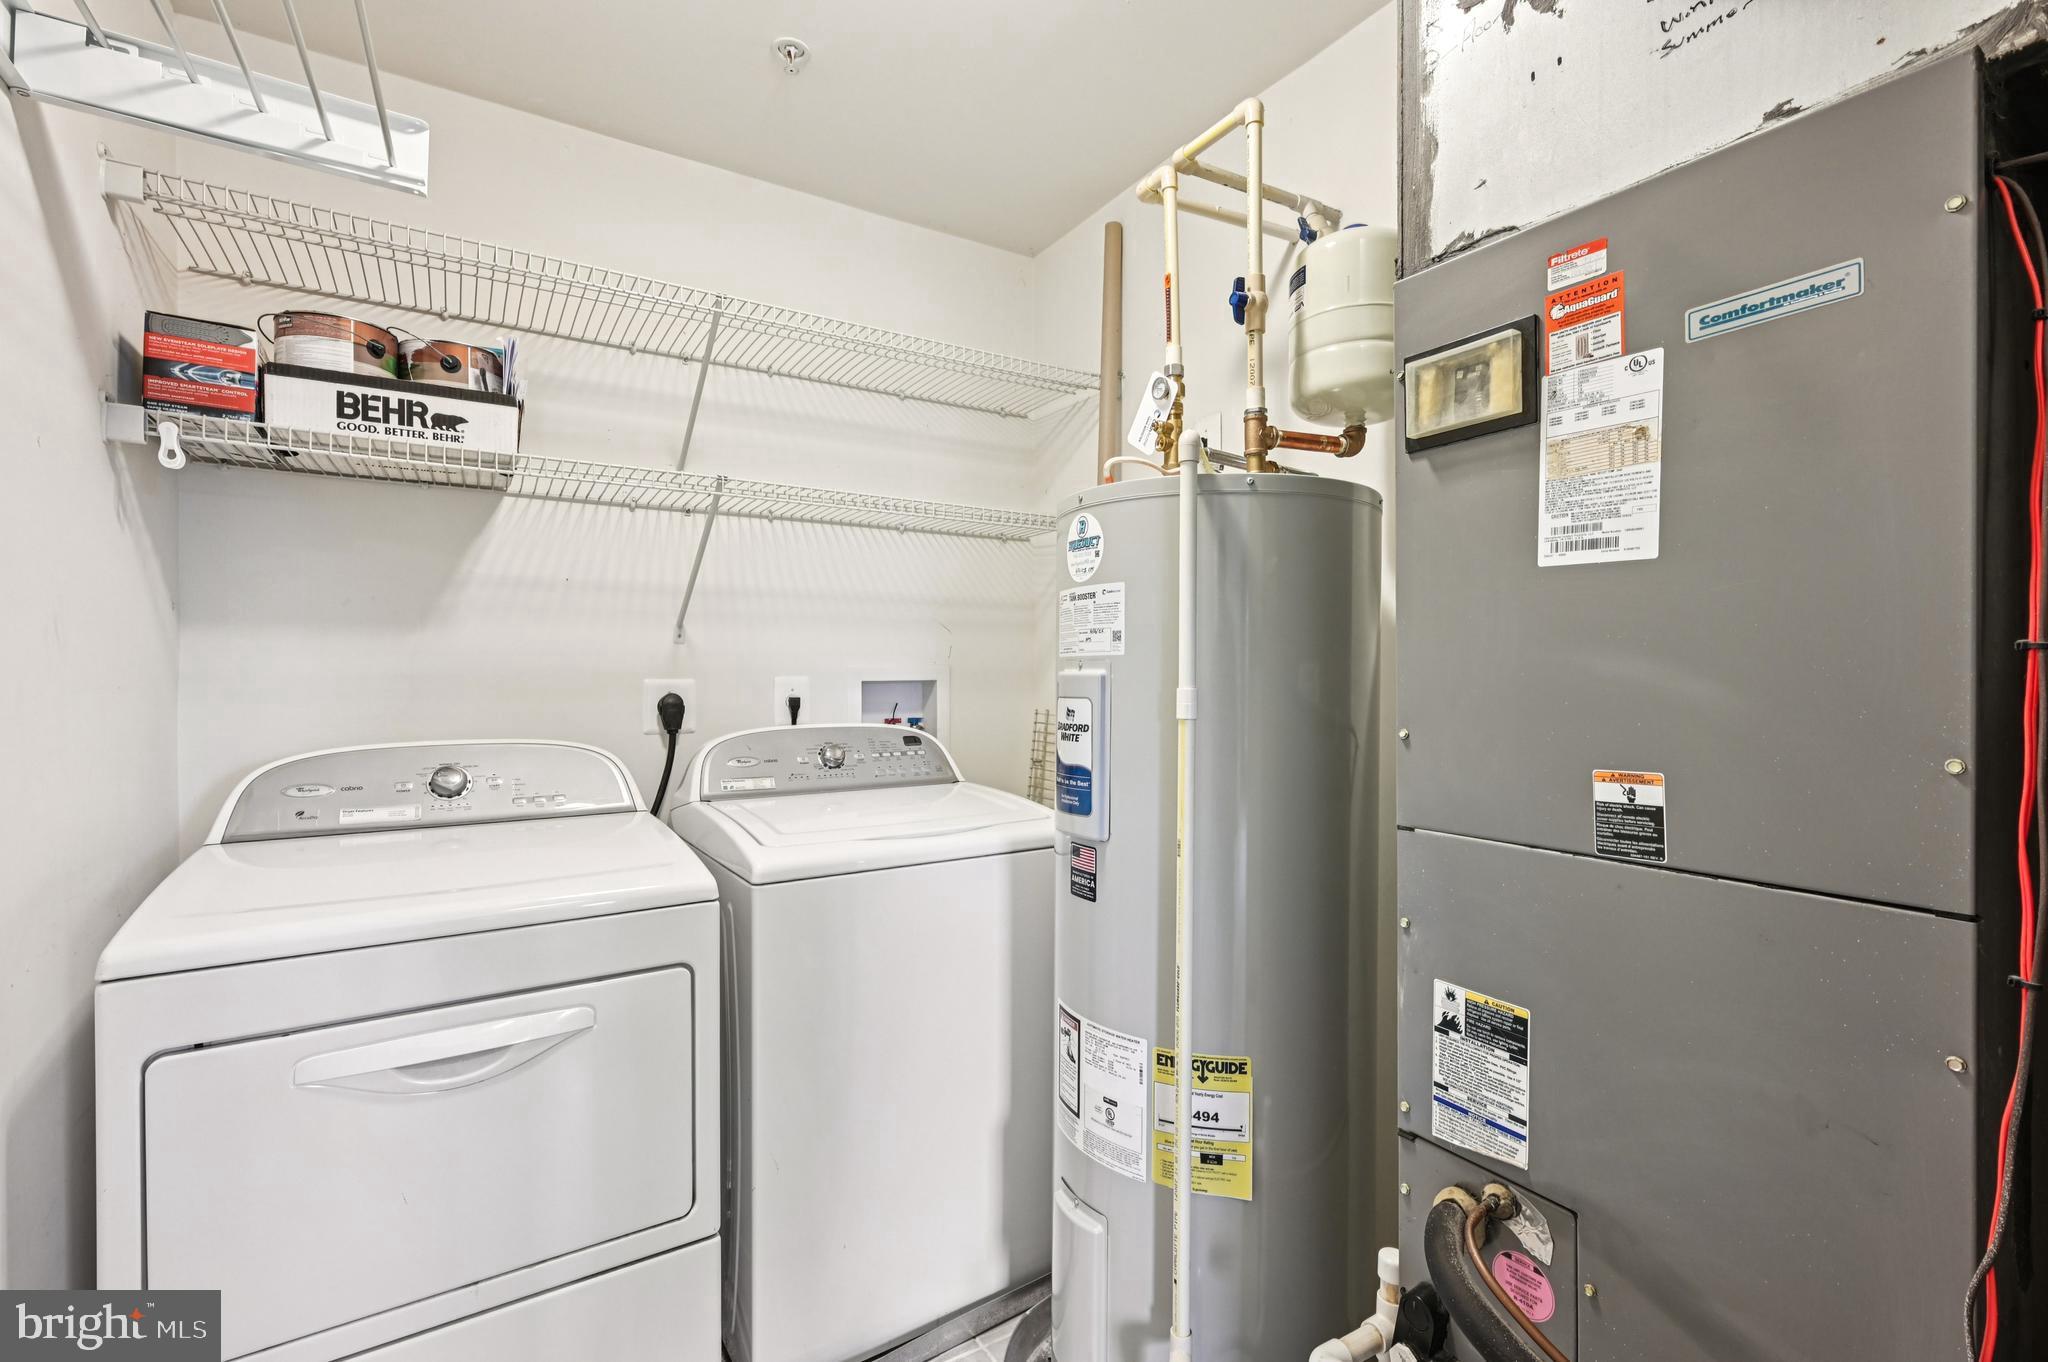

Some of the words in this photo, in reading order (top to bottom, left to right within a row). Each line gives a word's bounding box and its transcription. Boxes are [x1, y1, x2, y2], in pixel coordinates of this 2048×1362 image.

[1550, 247, 1588, 267] Filtrete
[1551, 277, 1618, 304] ATTENTION
[1564, 288, 1619, 313] AquaGuard
[1699, 278, 1846, 326] Comfortmaker
[147, 378, 179, 387] IMPROVED
[180, 382, 221, 392] SMARTSTEAM
[221, 389, 249, 397] CONTROL
[336, 390, 430, 429] BEHR
[336, 421, 380, 435] GOOD.
[384, 426, 429, 440] BETTER.
[1077, 591, 1097, 601] BOOSTER
[1057, 721, 1090, 733] BRADFORD
[1060, 731, 1080, 743] WHITE
[1072, 874, 1095, 889] AMERICA
[1491, 1001, 1515, 1013] CAUTION
